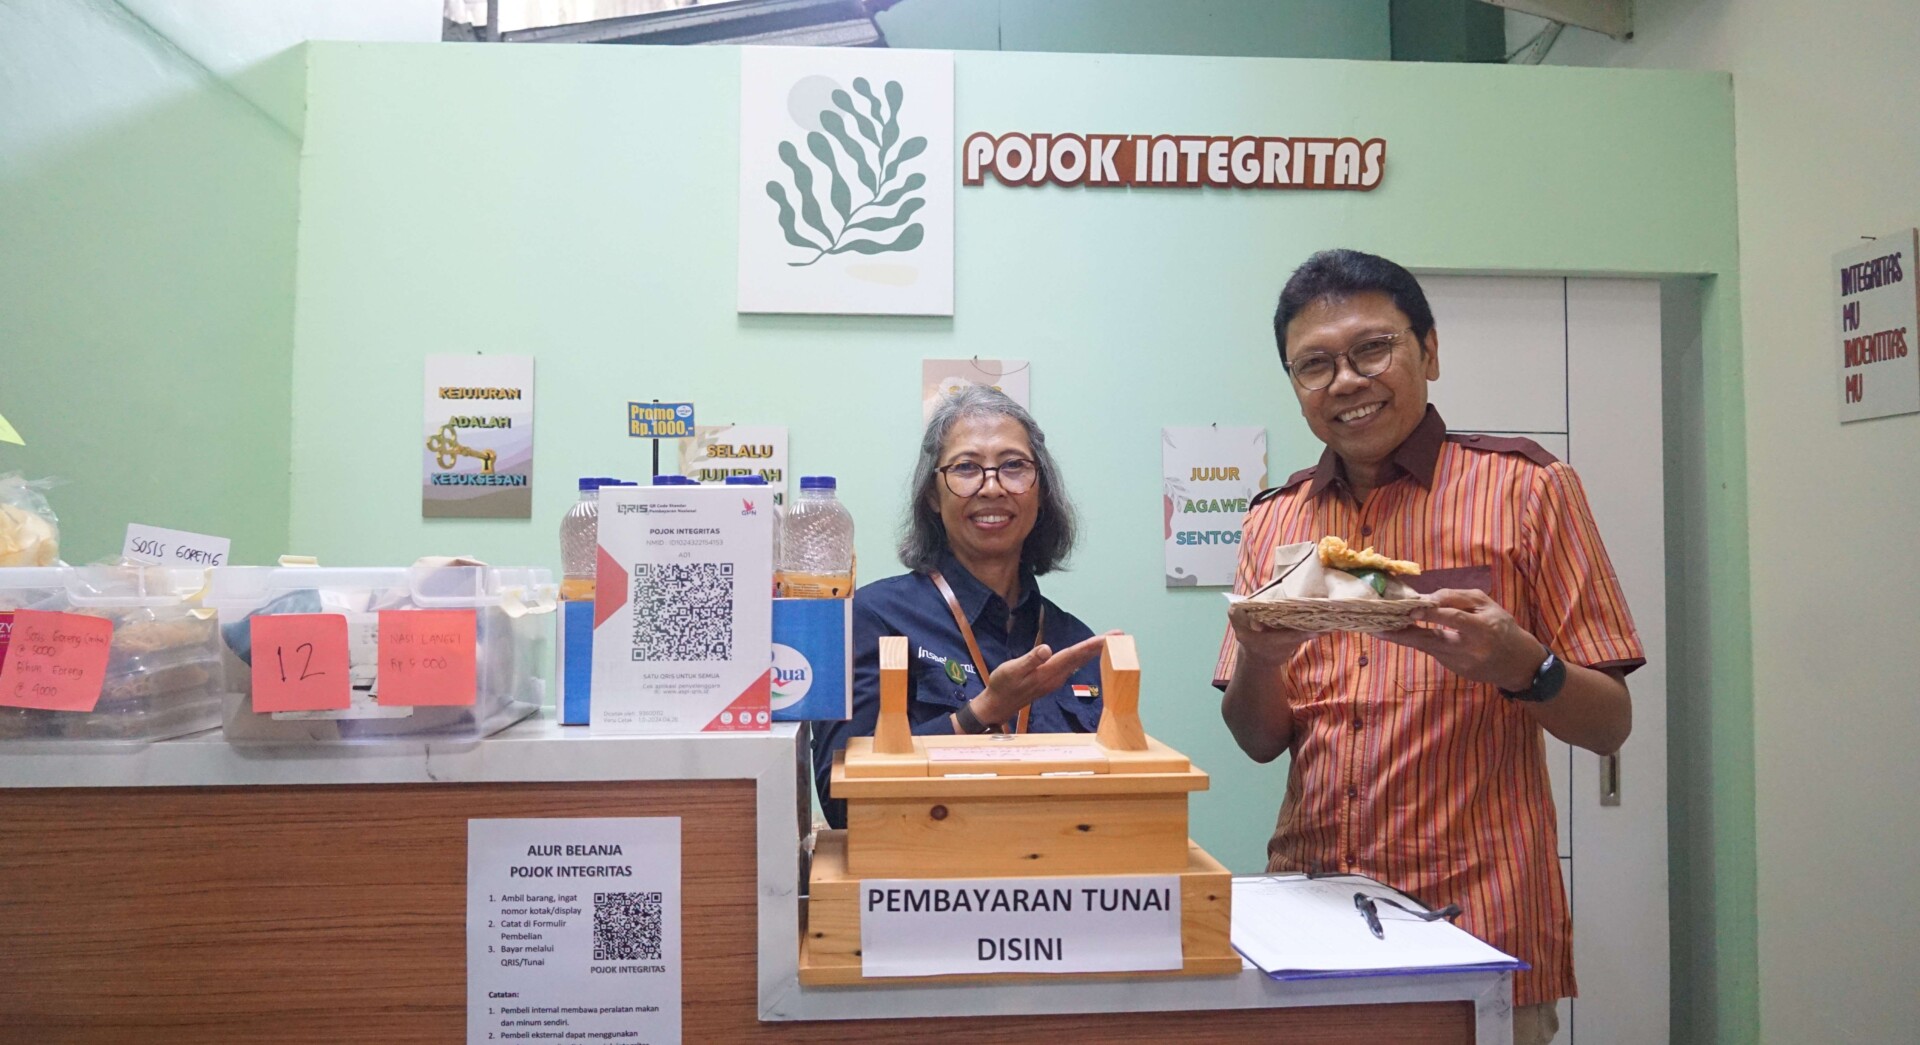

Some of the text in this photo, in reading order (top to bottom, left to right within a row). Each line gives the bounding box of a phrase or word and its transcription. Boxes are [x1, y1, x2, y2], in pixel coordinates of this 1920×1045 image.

[966, 134, 1384, 187] POJOK INTEGRITAS
[1841, 252, 1903, 297] INTEGRITAS
[1843, 301, 1860, 332] MU
[1844, 327, 1908, 369] INDENTITAS
[438, 387, 521, 400] KEJUJURAN
[1846, 373, 1863, 404] MU
[631, 404, 675, 421] Promo
[449, 416, 511, 428] ADALAH
[631, 420, 694, 436] Rp.1000,-
[706, 445, 773, 458] SELALU
[431, 473, 526, 486] KESUKSESAN
[1190, 467, 1240, 481] JUJUR
[617, 503, 648, 516] QRIS
[1183, 498, 1248, 513] AGAWE
[1176, 530, 1242, 545] SENTOS
[131, 537, 223, 567] SOSIS GORENG
[24, 626, 45, 643] Sosis
[390, 633, 414, 645] NASI
[277, 642, 326, 682] 12
[527, 844, 623, 856] ALUR BELANJA
[510, 865, 632, 878] POJOK INTEGRITAS
[501, 894, 524, 902] Ambil
[527, 894, 556, 904] barang,
[558, 894, 577, 903] ingat
[868, 887, 1171, 913] PEMBAYARAN TUNAI
[530, 906, 582, 916] kotak/display
[533, 919, 567, 927] Formulir
[501, 932, 543, 940] Pembelian
[501, 945, 523, 954] Bayar
[977, 937, 1064, 961] DISINI
[500, 958, 545, 967] QRIS/Tunai
[590, 965, 666, 974] POJOK INTEGRITAS
[501, 1006, 530, 1014] Pembeli
[531, 1006, 559, 1014] internal
[599, 1005, 633, 1015] peralatan
[500, 1019, 514, 1027] dan
[501, 1031, 530, 1039] Pembeli
[531, 1031, 564, 1039] eksternal
[565, 1031, 586, 1040] dapat
[587, 1030, 638, 1040] menggunakan
